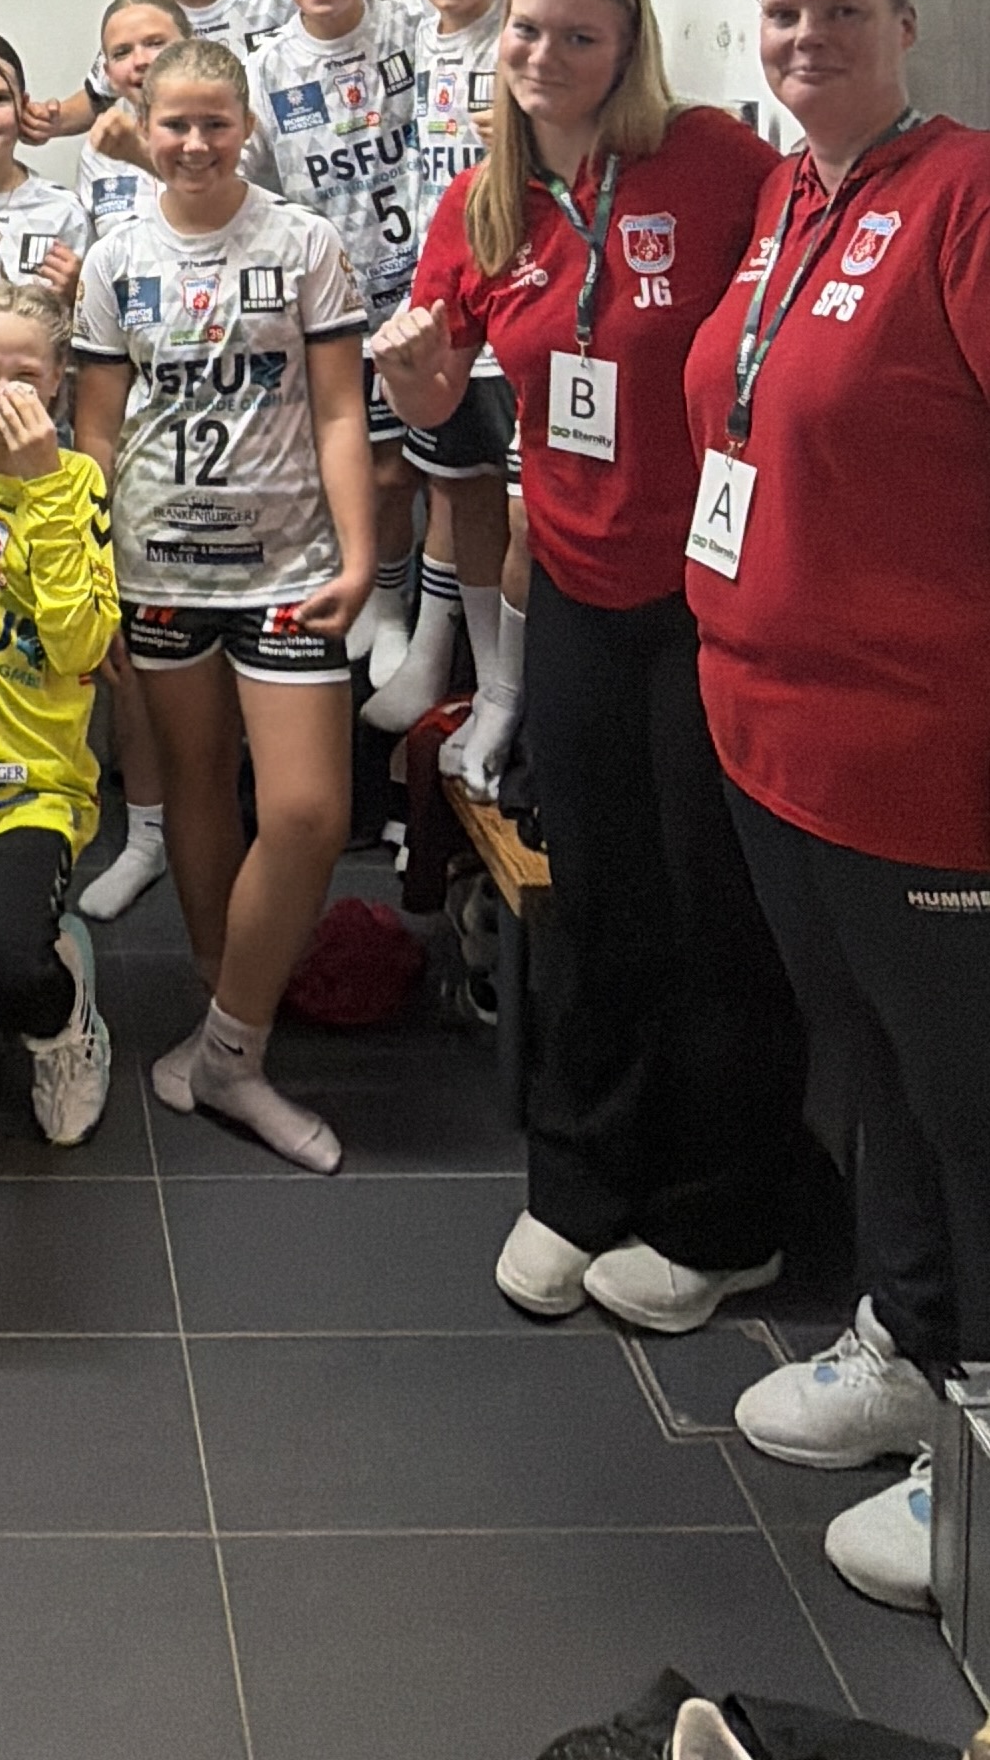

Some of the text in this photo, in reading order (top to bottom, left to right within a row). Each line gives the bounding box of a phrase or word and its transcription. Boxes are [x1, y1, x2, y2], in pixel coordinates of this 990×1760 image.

[305, 129, 404, 188] PSFU
[421, 147, 472, 181] SFU
[371, 186, 412, 244] 5
[243, 299, 284, 309] KEMNA
[633, 276, 672, 309] JG
[812, 280, 865, 321] SPS
[571, 377, 596, 419] B
[169, 419, 230, 486] 12
[573, 428, 613, 448] Eternity
[708, 482, 731, 533] A
